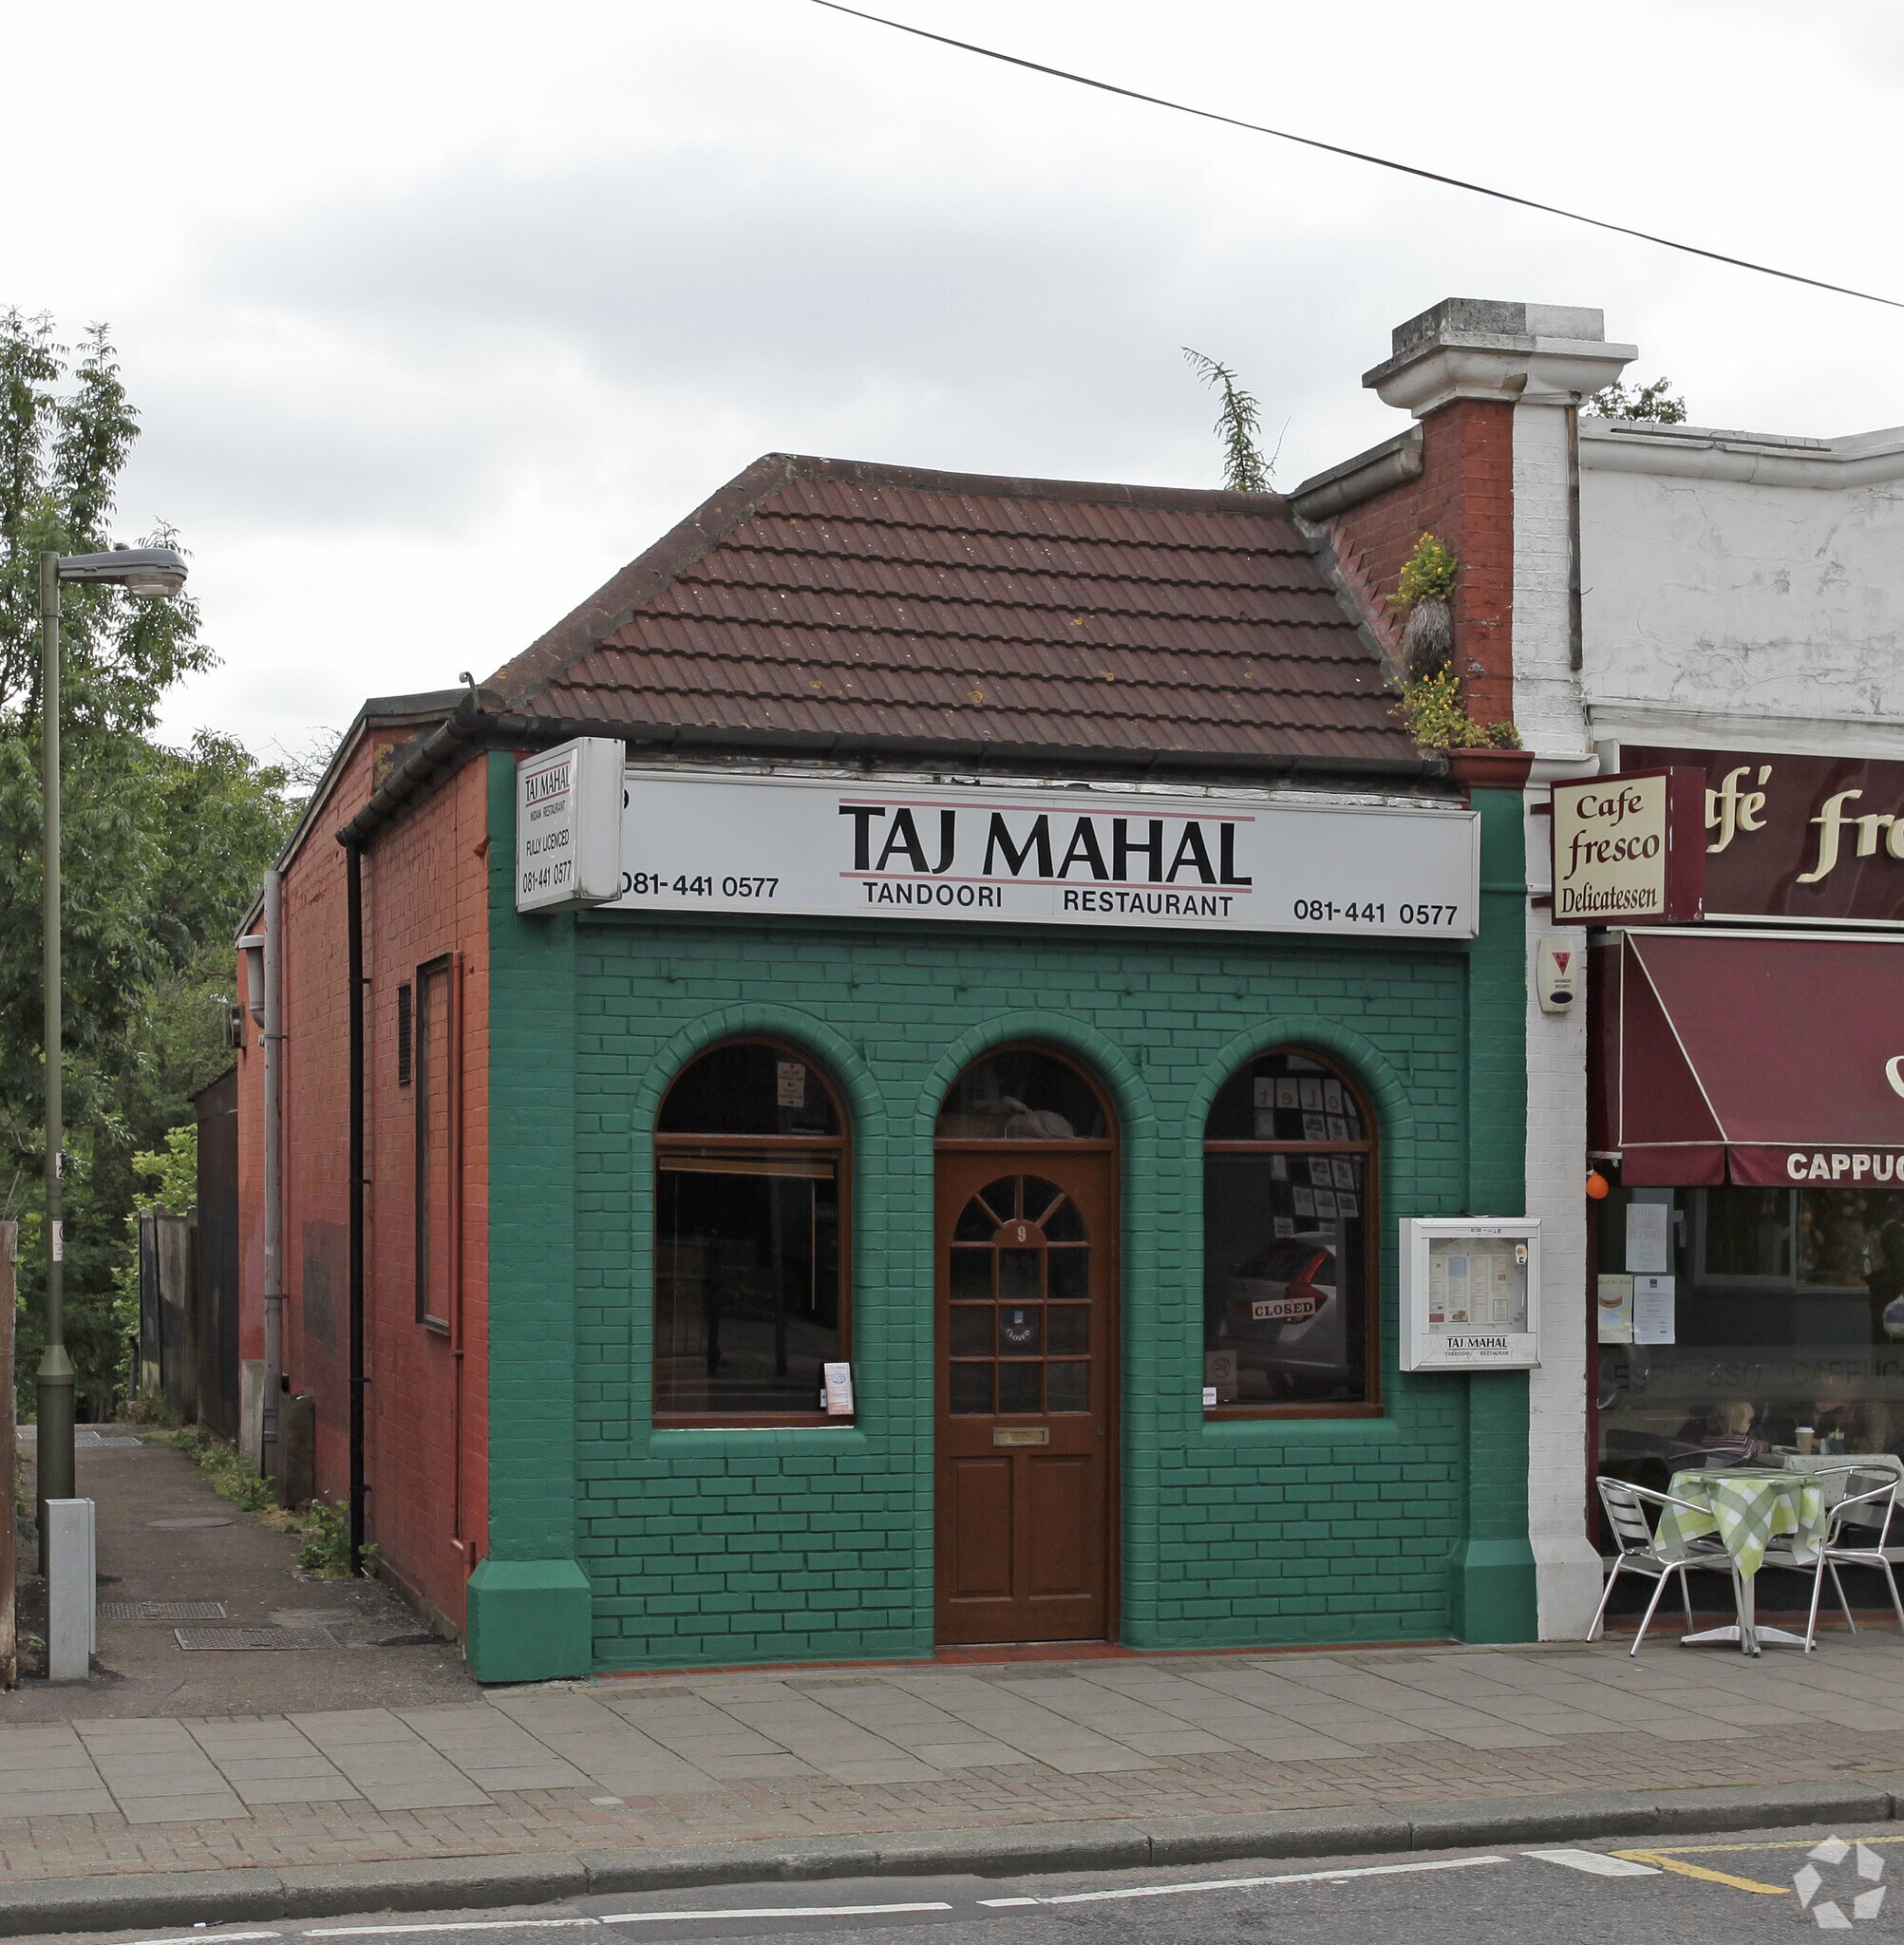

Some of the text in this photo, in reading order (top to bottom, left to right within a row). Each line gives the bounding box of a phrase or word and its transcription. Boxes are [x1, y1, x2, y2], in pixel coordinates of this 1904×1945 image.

[525, 765, 570, 802] TAJ MAHAL
[530, 800, 566, 822] INDIAN RESTAURANT
[1575, 785, 1645, 828] Cafe
[526, 828, 570, 857] FULLY LICENCED
[839, 804, 1254, 886] TAJ MAHAL
[1562, 828, 1661, 881] fresco
[553, 859, 572, 885] 0577
[722, 876, 780, 898] 0577
[862, 881, 1234, 917] TANDOORI RESTAURANT
[1561, 883, 1658, 914] Delicatessen
[1292, 898, 1459, 926] 081-441 0577
[1017, 1225, 1027, 1242] 9
[1254, 1302, 1313, 1317] CLOSED
[1006, 1329, 1030, 1342] CLOSED
[1446, 1337, 1508, 1348] TAJ MAHAL
[1613, 1361, 1763, 1390] ESPESSO
